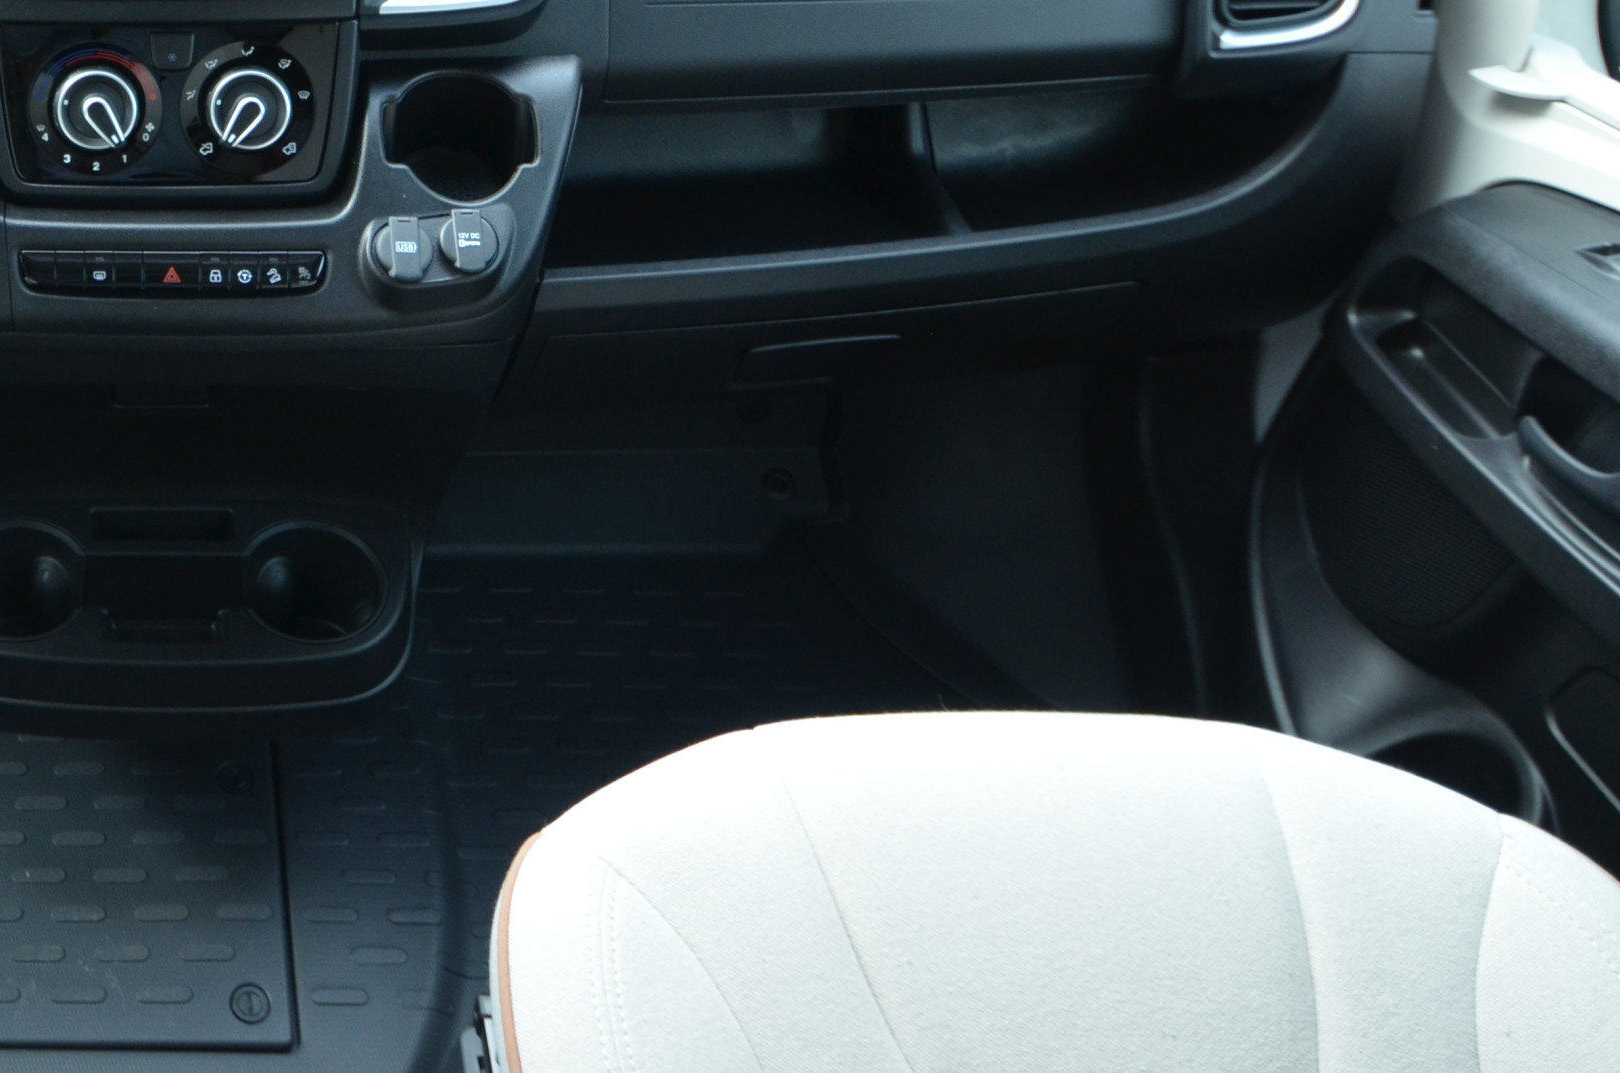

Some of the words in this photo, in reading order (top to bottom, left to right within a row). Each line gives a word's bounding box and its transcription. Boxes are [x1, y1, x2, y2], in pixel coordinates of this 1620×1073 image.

[41, 132, 49, 142] 4
[142, 132, 150, 141] 0
[63, 153, 71, 164] 3
[121, 154, 128, 163] 1
[92, 161, 100, 171] 2
[397, 243, 414, 251] USB
